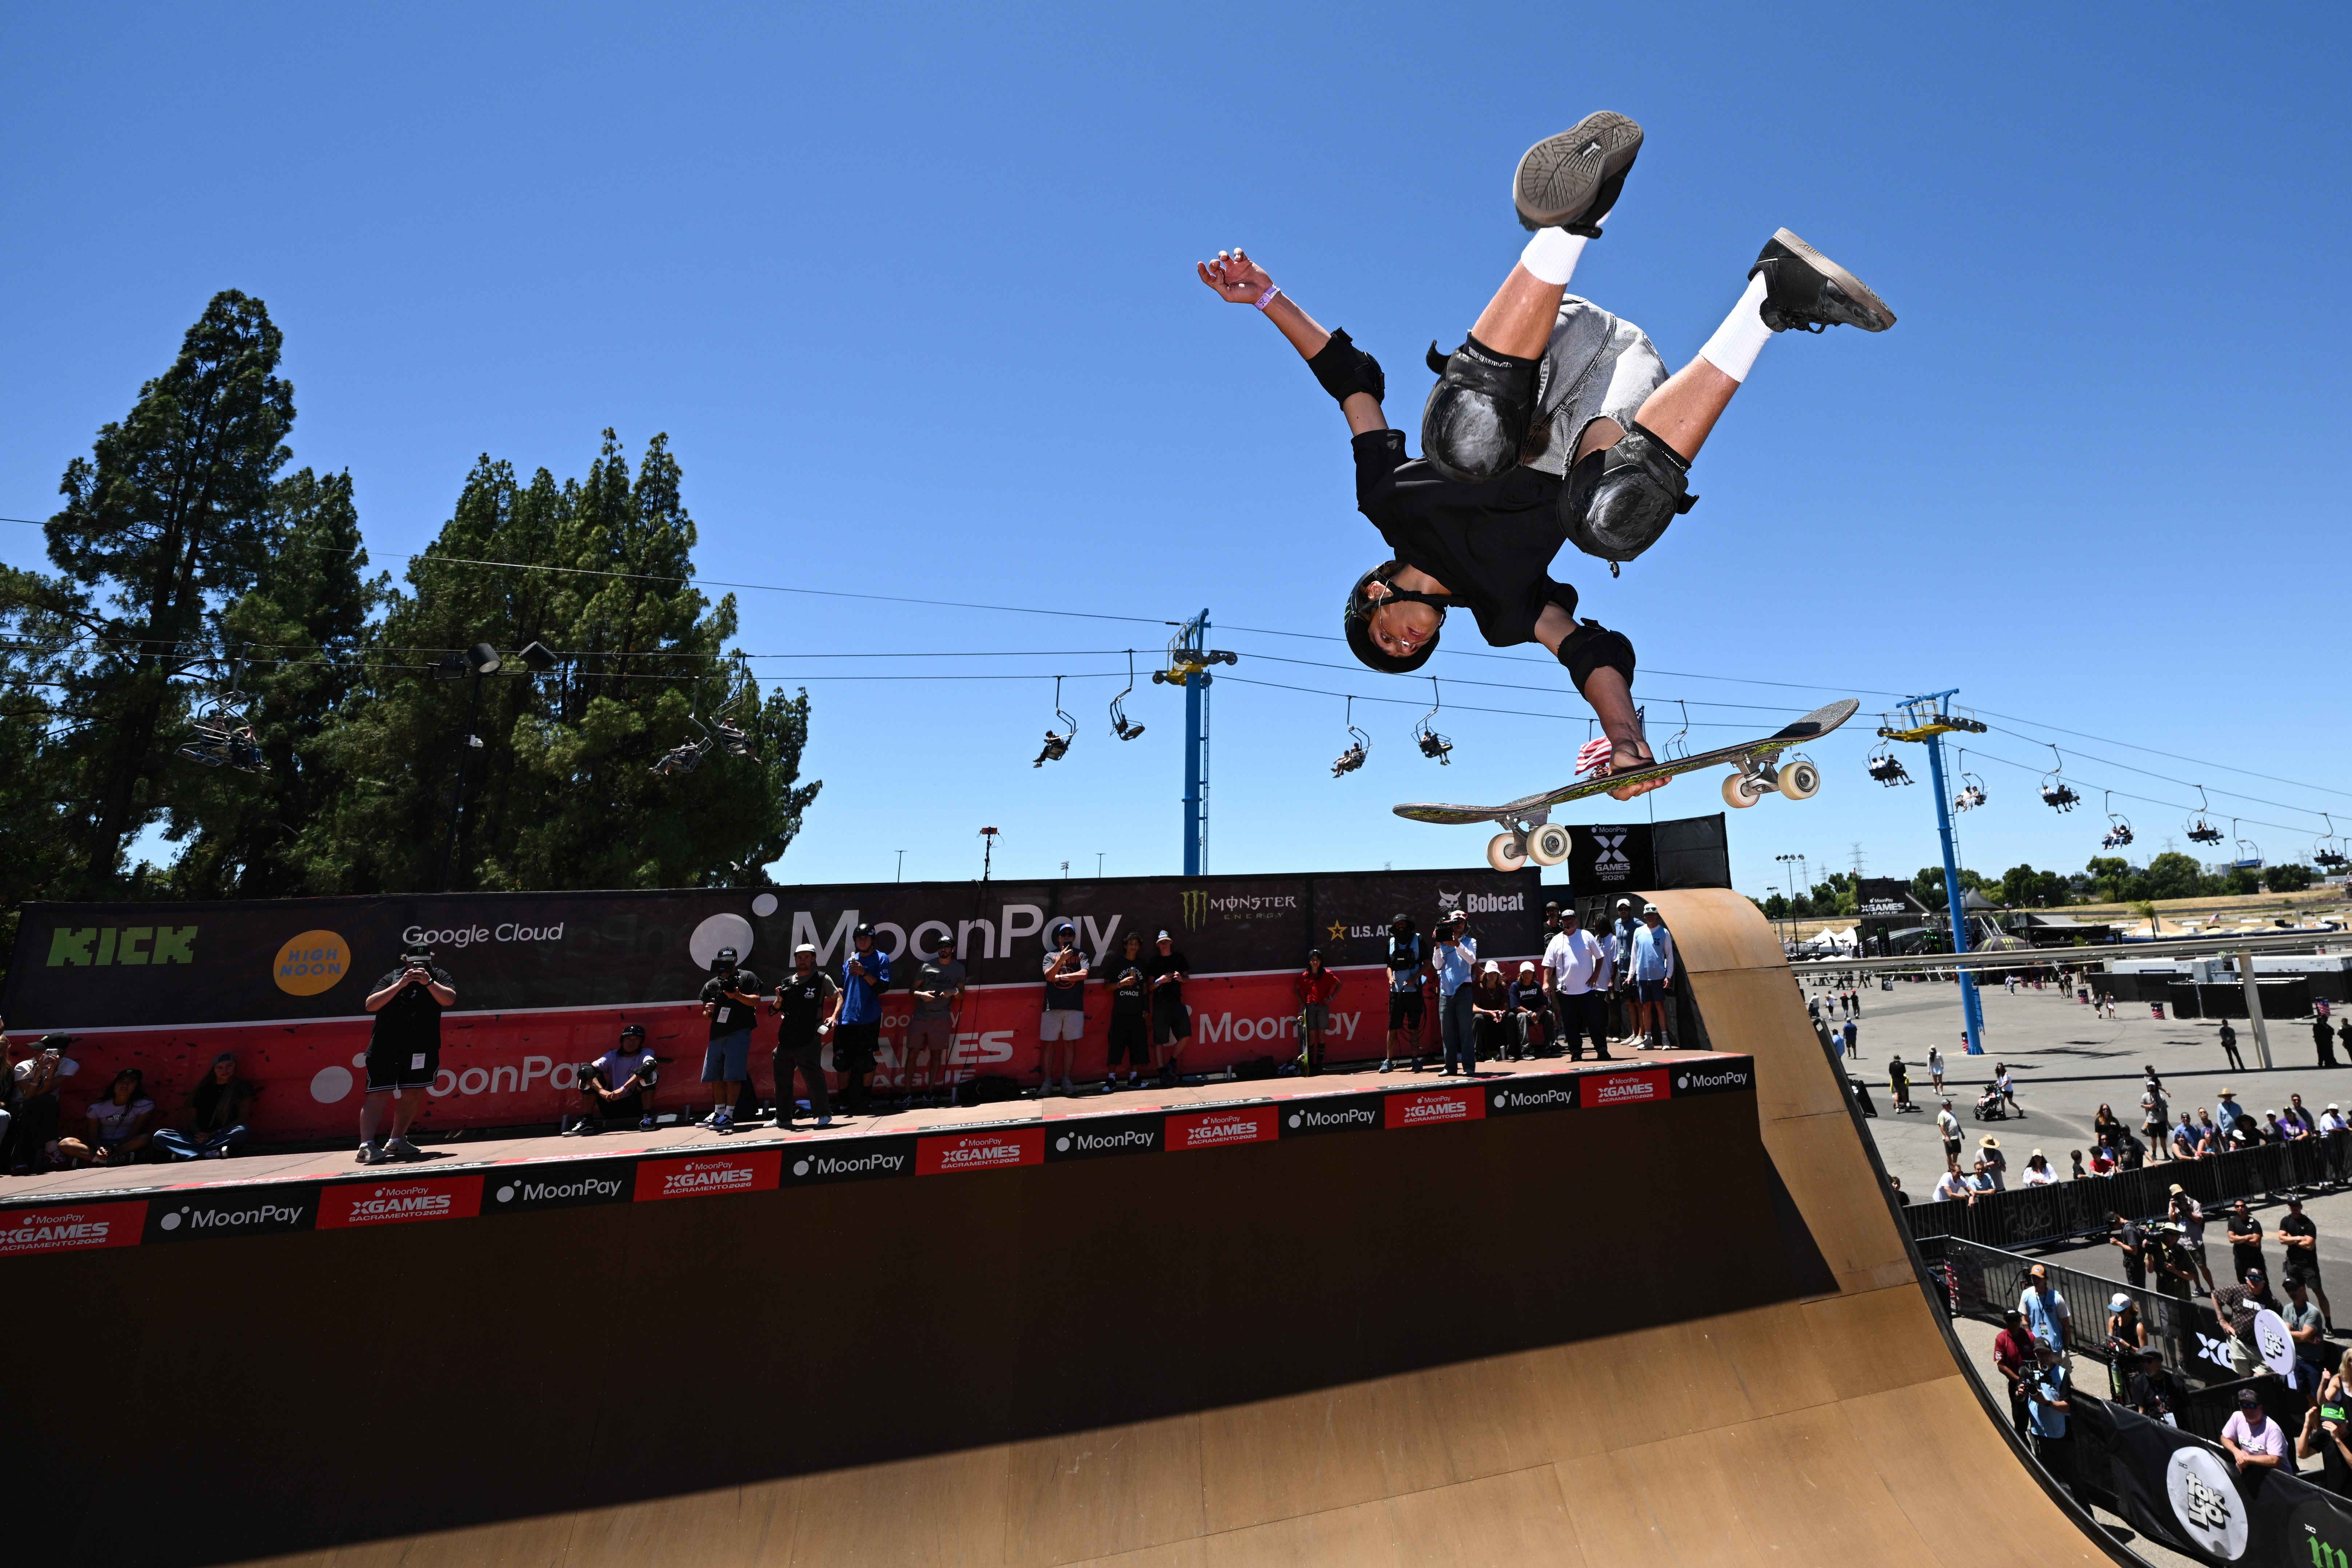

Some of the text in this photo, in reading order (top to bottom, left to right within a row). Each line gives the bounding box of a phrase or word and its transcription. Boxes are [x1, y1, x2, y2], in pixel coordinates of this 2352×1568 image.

[1595, 863, 1630, 871] GAMES
[1210, 895, 1297, 911] MONSTER
[1467, 892, 1524, 913] Bobcat
[403, 924, 490, 948] Google
[495, 922, 564, 942] Cloud
[789, 904, 1122, 968] MoonPay
[1351, 926, 1374, 937] U.S.
[46, 926, 198, 966] KICK
[288, 949, 338, 961] HIGH
[280, 963, 341, 977] NOON
[1118, 968, 1143, 981] DISODER
[1199, 1011, 1361, 1044] Moonay
[1693, 1072, 1747, 1088] MoonPay
[1511, 1089, 1572, 1106] MoonPay
[1210, 1116, 1240, 1124] MoonPay
[1307, 1109, 1375, 1126] MoonPay
[969, 1138, 1002, 1146] MoonPay
[1077, 1131, 1154, 1150] MoonPay
[695, 1161, 732, 1170] MoonPay
[818, 1154, 904, 1174] MoonPay
[386, 1187, 429, 1197] MoonPay
[523, 1179, 622, 1200] MoonPay
[36, 1214, 85, 1224] MoonPay
[192, 1205, 303, 1228] MoonPay
[0, 1241, 76, 1251] ACRAMENTO
